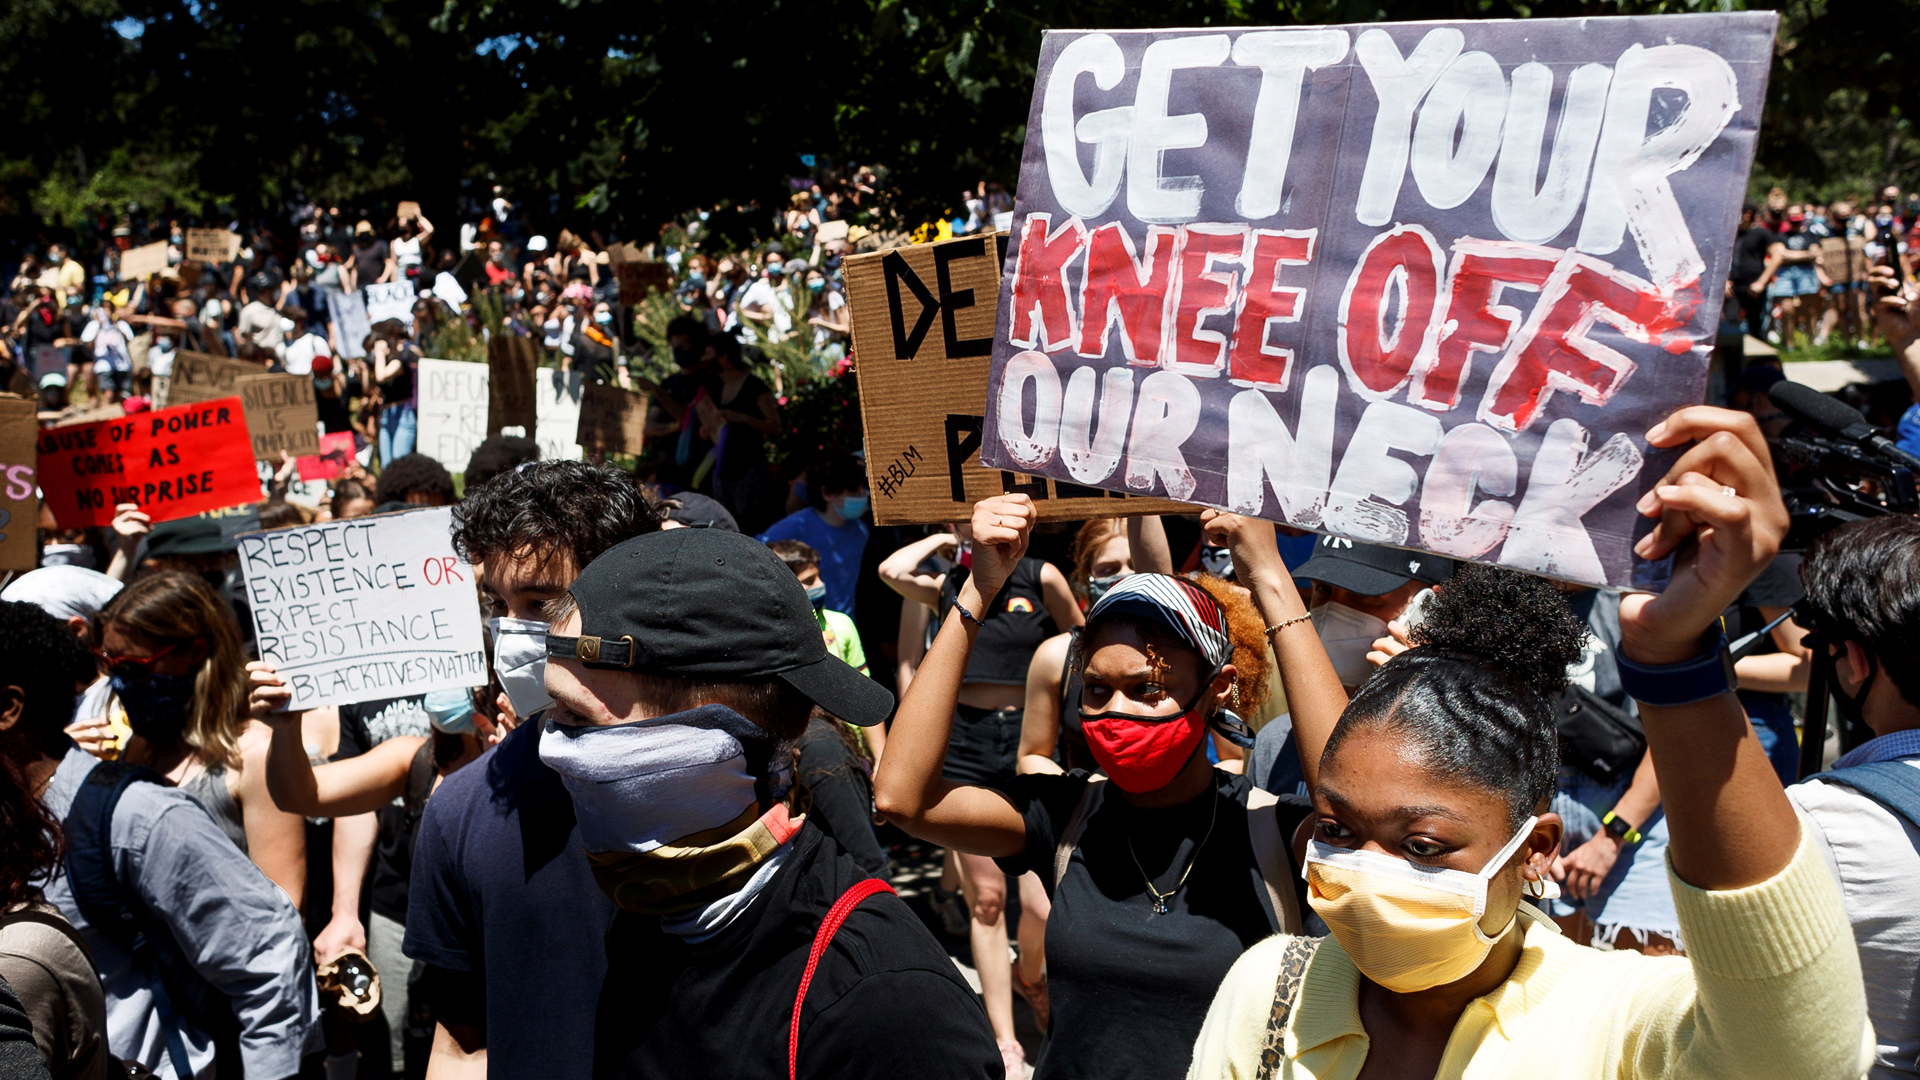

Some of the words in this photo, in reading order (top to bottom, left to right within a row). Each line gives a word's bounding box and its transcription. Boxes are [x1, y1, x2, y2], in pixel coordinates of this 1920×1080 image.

[1041, 29, 1350, 223] GET
[1355, 27, 1741, 294] YOUR
[882, 237, 1005, 361] DE
[1009, 212, 1318, 392] KNEE
[1337, 222, 1701, 435] OFF
[242, 377, 314, 409] SILENCE
[110, 422, 136, 443] OF
[151, 407, 231, 437] POWER
[266, 409, 287, 432] IS
[72, 452, 124, 476] COMES
[149, 444, 180, 468] AS
[877, 445, 923, 498] #BLM
[996, 350, 1201, 501] OUR
[1227, 364, 1644, 586] NECK
[76, 487, 105, 511] NO
[111, 470, 214, 507] SURPRISE
[240, 523, 376, 572] RESPECT
[250, 562, 415, 604] EXISTENCE
[423, 556, 464, 586] OR
[254, 598, 358, 634] EXPECT
[260, 608, 453, 663] RESISTANCE
